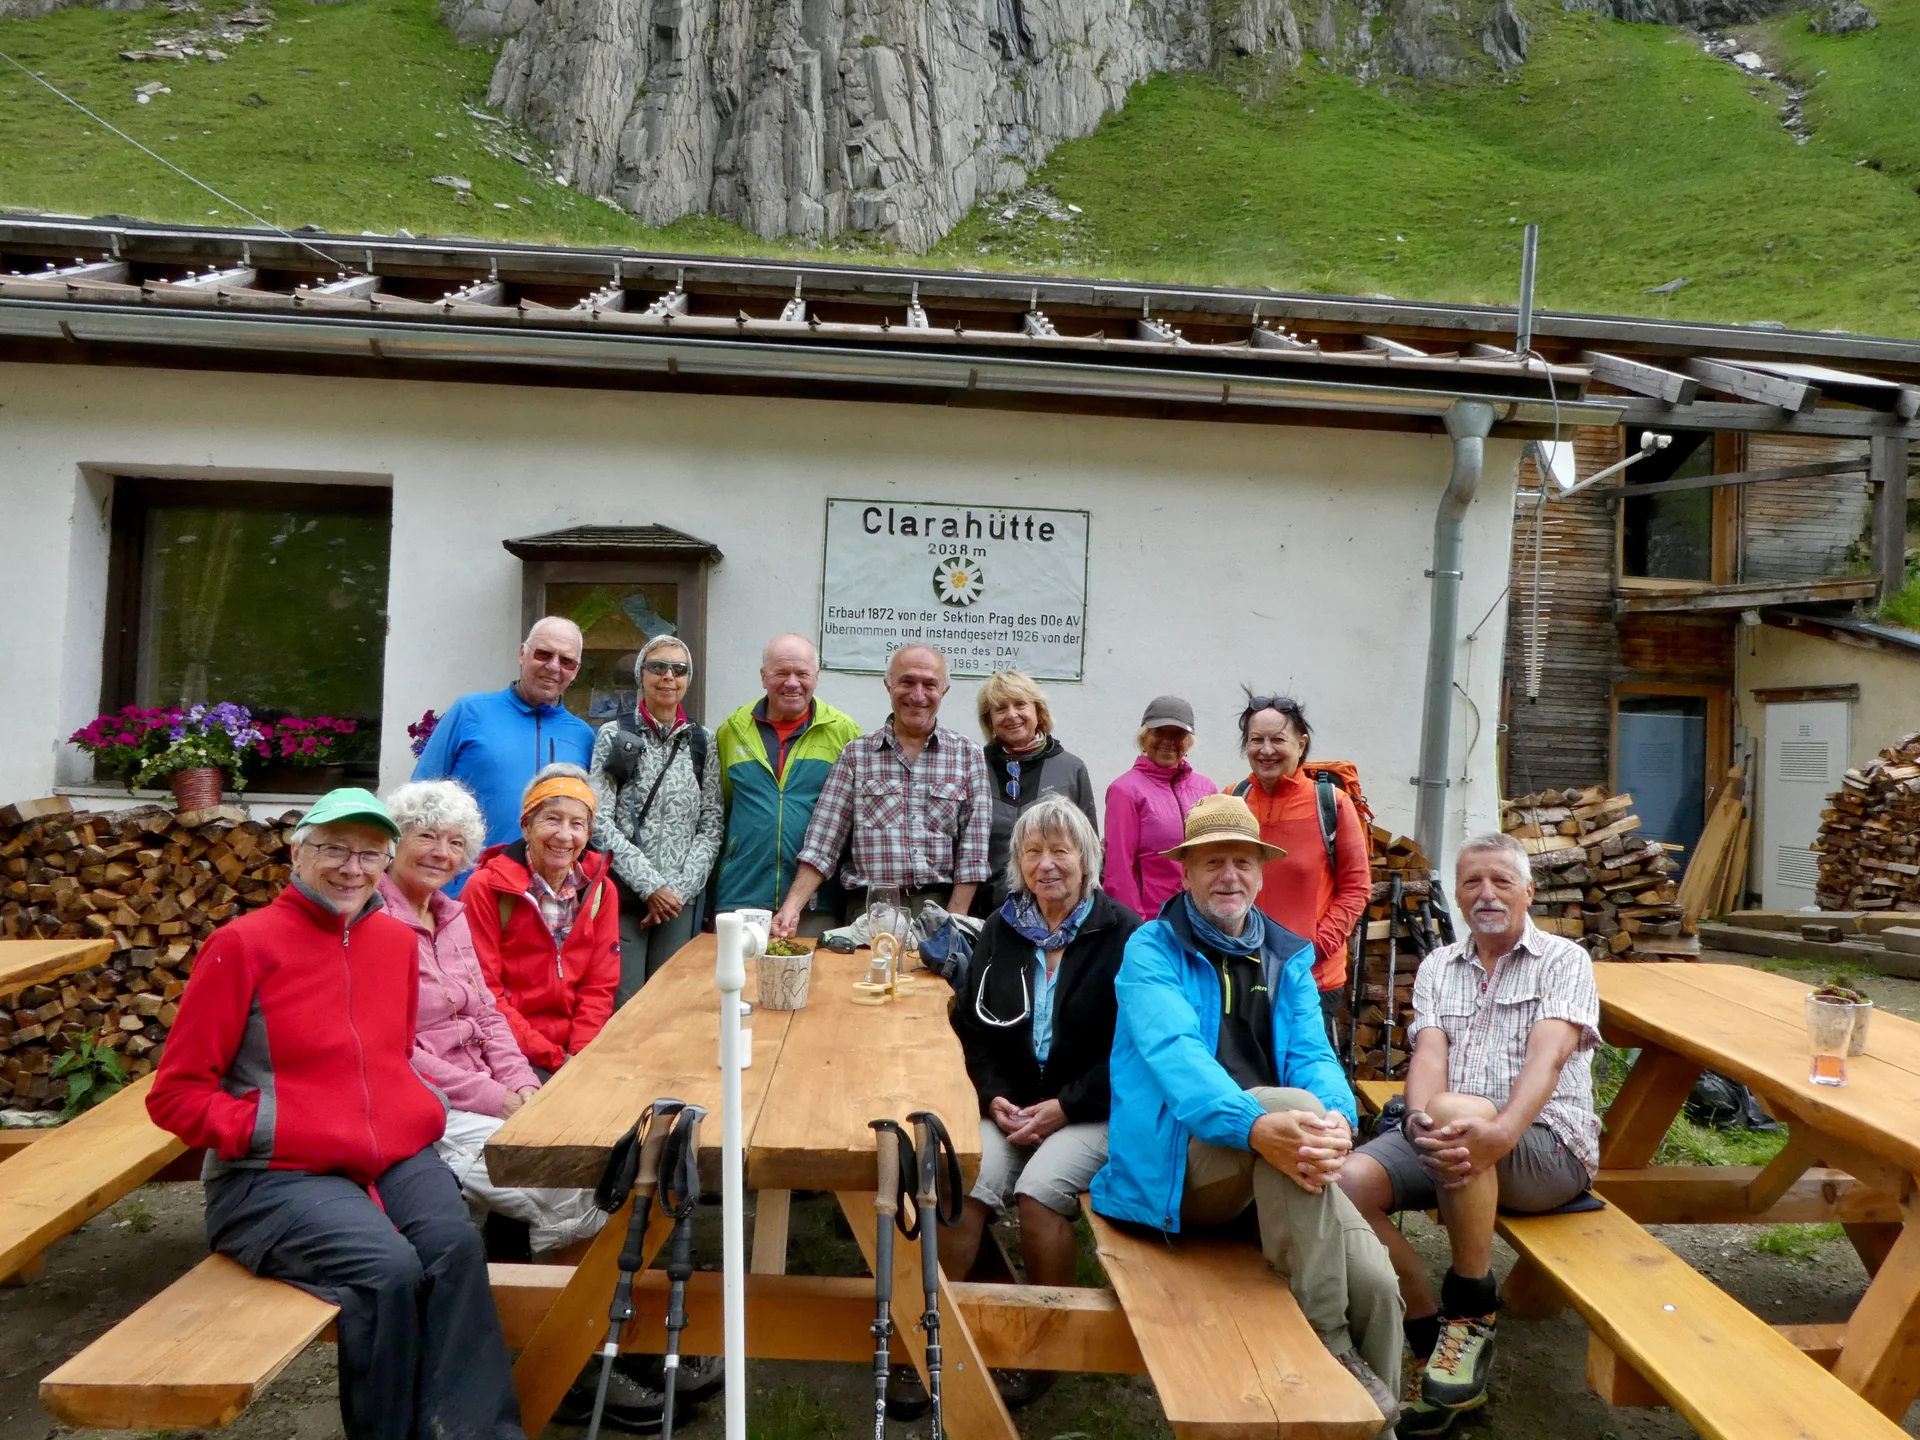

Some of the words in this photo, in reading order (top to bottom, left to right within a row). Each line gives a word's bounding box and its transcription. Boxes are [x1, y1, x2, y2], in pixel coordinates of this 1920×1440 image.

[863, 507, 1055, 542] Clarahütte
[928, 543, 968, 555] 2038
[973, 546, 986, 557] m
[828, 606, 865, 619] Erbaut
[868, 608, 894, 620] 1872
[897, 611, 916, 621] von
[920, 610, 937, 622] der
[943, 611, 984, 624] Sektion
[989, 612, 1014, 627] Prag
[1017, 614, 1037, 626] des
[825, 622, 897, 636] Übernommen
[902, 626, 921, 638] und
[926, 626, 1008, 642] instandgesetzt
[1012, 630, 1039, 642] 1926
[1041, 634, 1060, 643] von
[1063, 633, 1080, 644] der
[972, 646, 991, 656] des
[996, 646, 1020, 657] DAV
[953, 658, 979, 669] 1969
